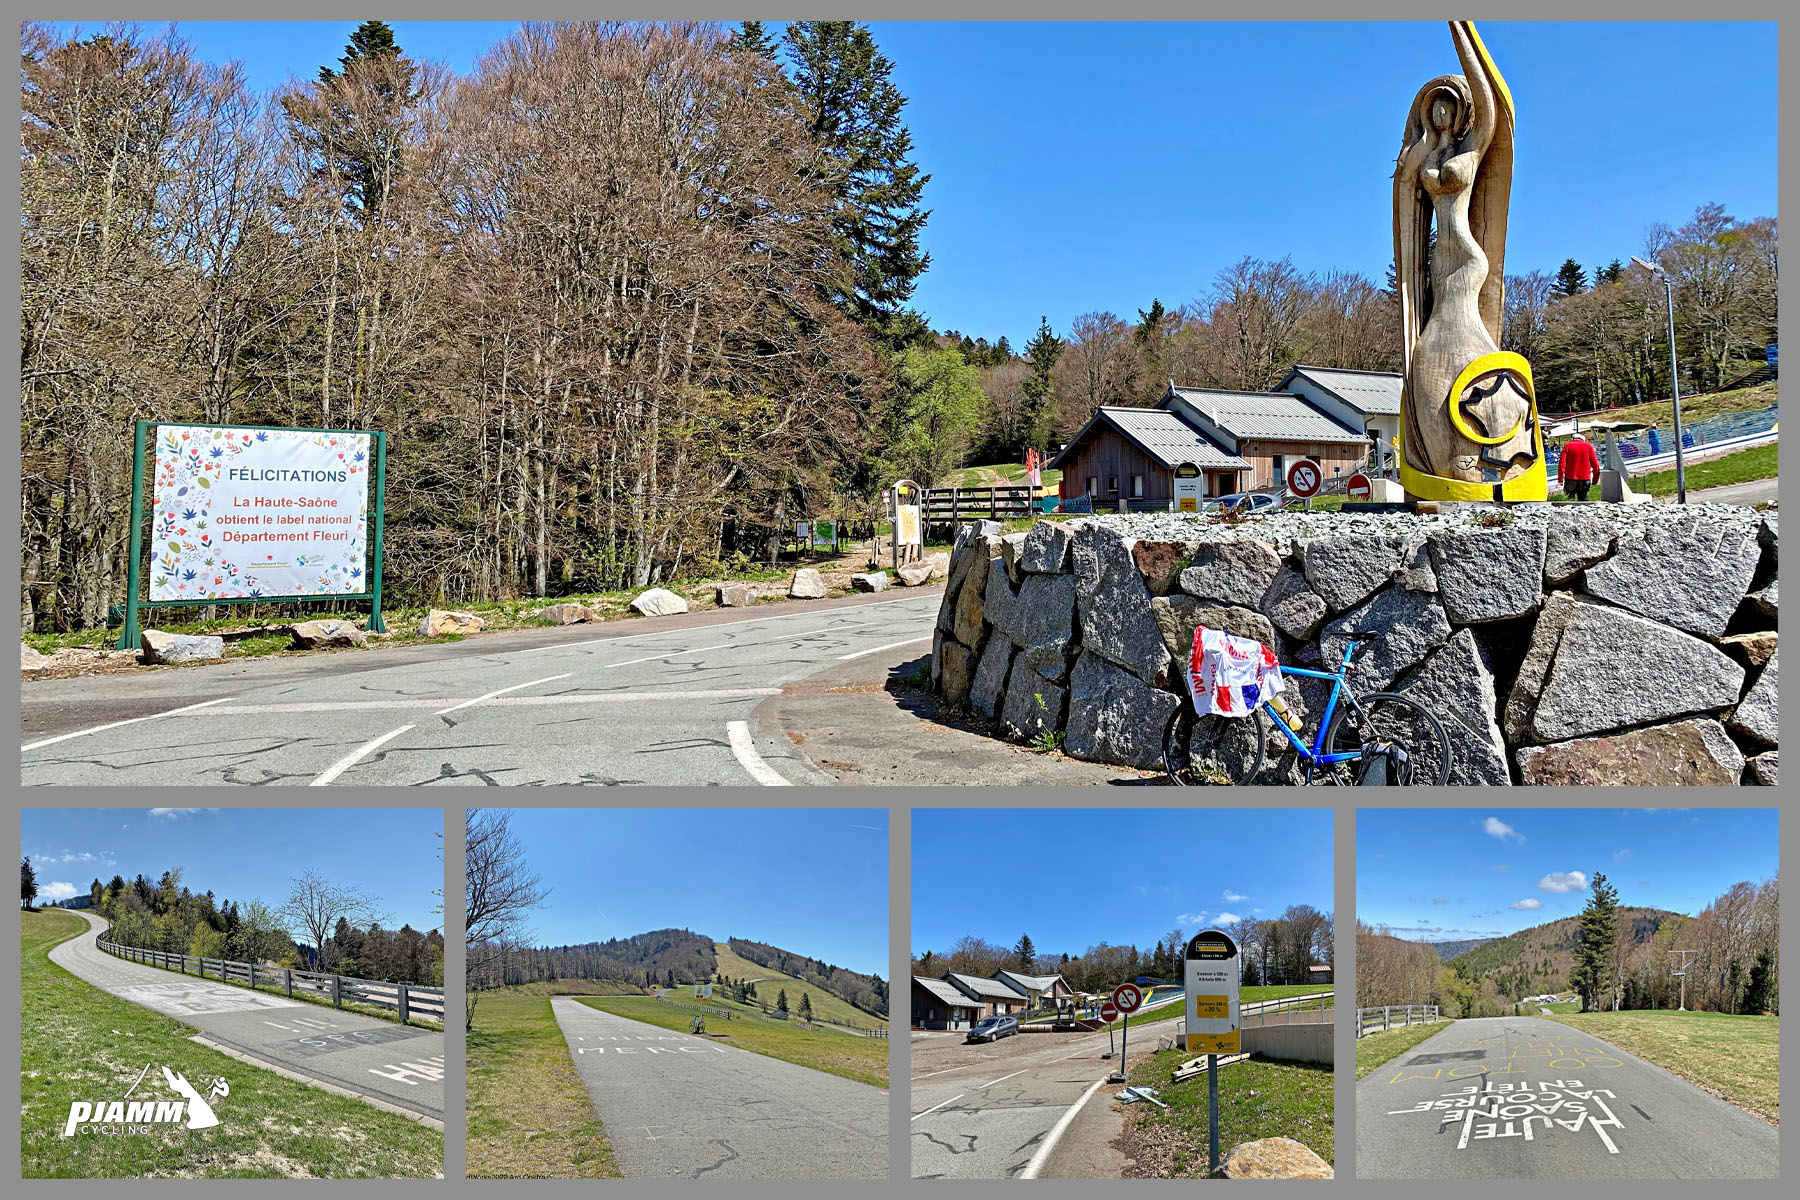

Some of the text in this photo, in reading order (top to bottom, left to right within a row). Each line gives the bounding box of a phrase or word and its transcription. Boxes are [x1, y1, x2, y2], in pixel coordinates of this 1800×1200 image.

[229, 466, 347, 483] FÉLICITATIONS
[233, 497, 338, 508] La Haute-Saône
[216, 514, 352, 525] obtient le label national
[222, 530, 348, 544] Département Fleuri
[578, 1046, 726, 1054] MERCI
[1388, 1056, 1624, 1084] GO TOM
[1441, 1079, 1585, 1096] EN TÊTE
[1388, 1089, 1617, 1115] LA COURSE
[1442, 1099, 1587, 1150] SAÔNE
[1474, 1096, 1625, 1154] HAUTE
